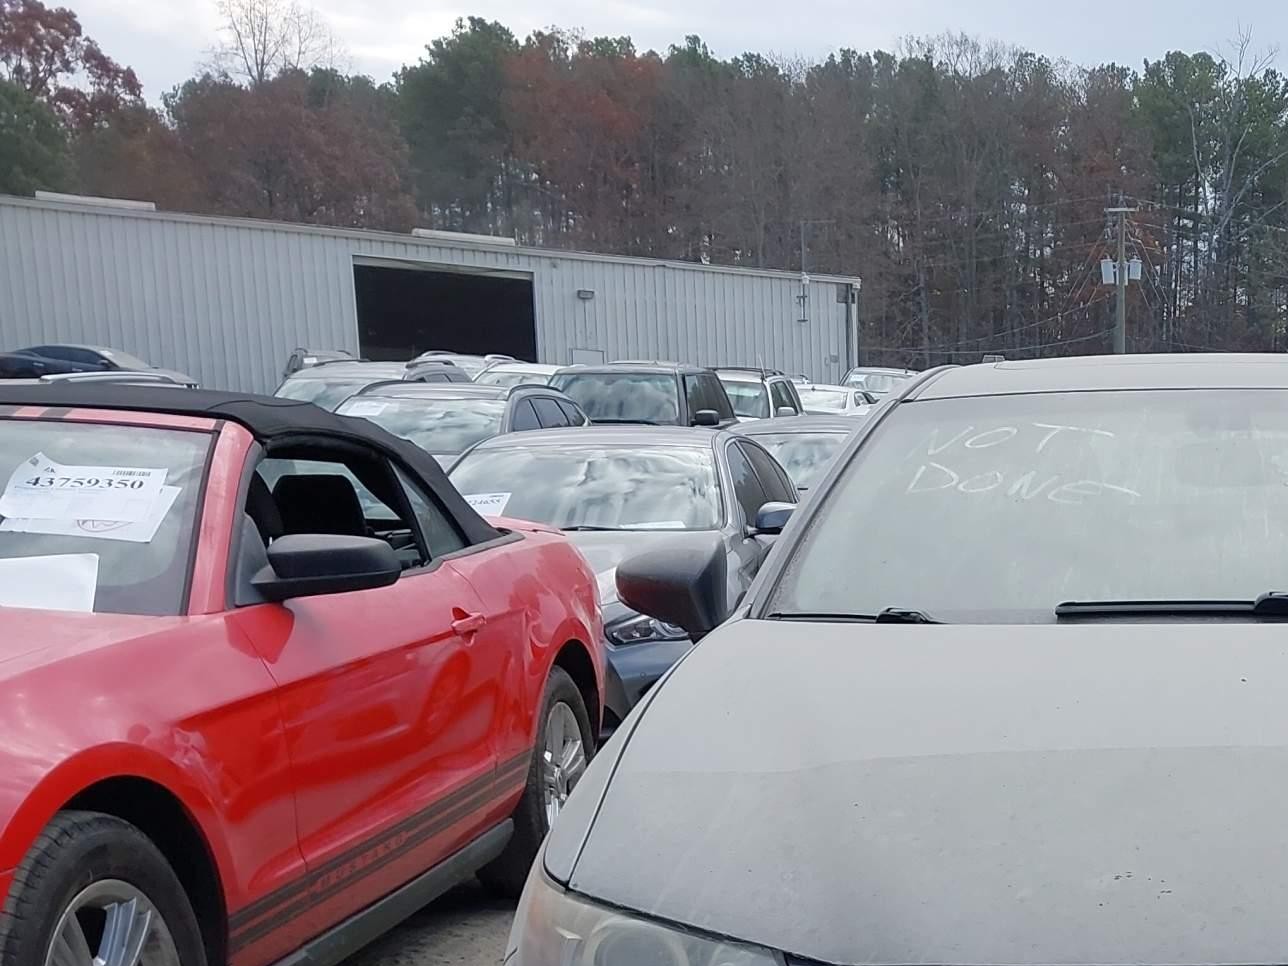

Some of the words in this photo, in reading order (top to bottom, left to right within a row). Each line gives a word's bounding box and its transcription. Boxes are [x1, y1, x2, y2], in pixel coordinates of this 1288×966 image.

[904, 422, 1115, 461] NOT
[25, 476, 145, 490] 43759350
[905, 461, 1142, 505] DONE
